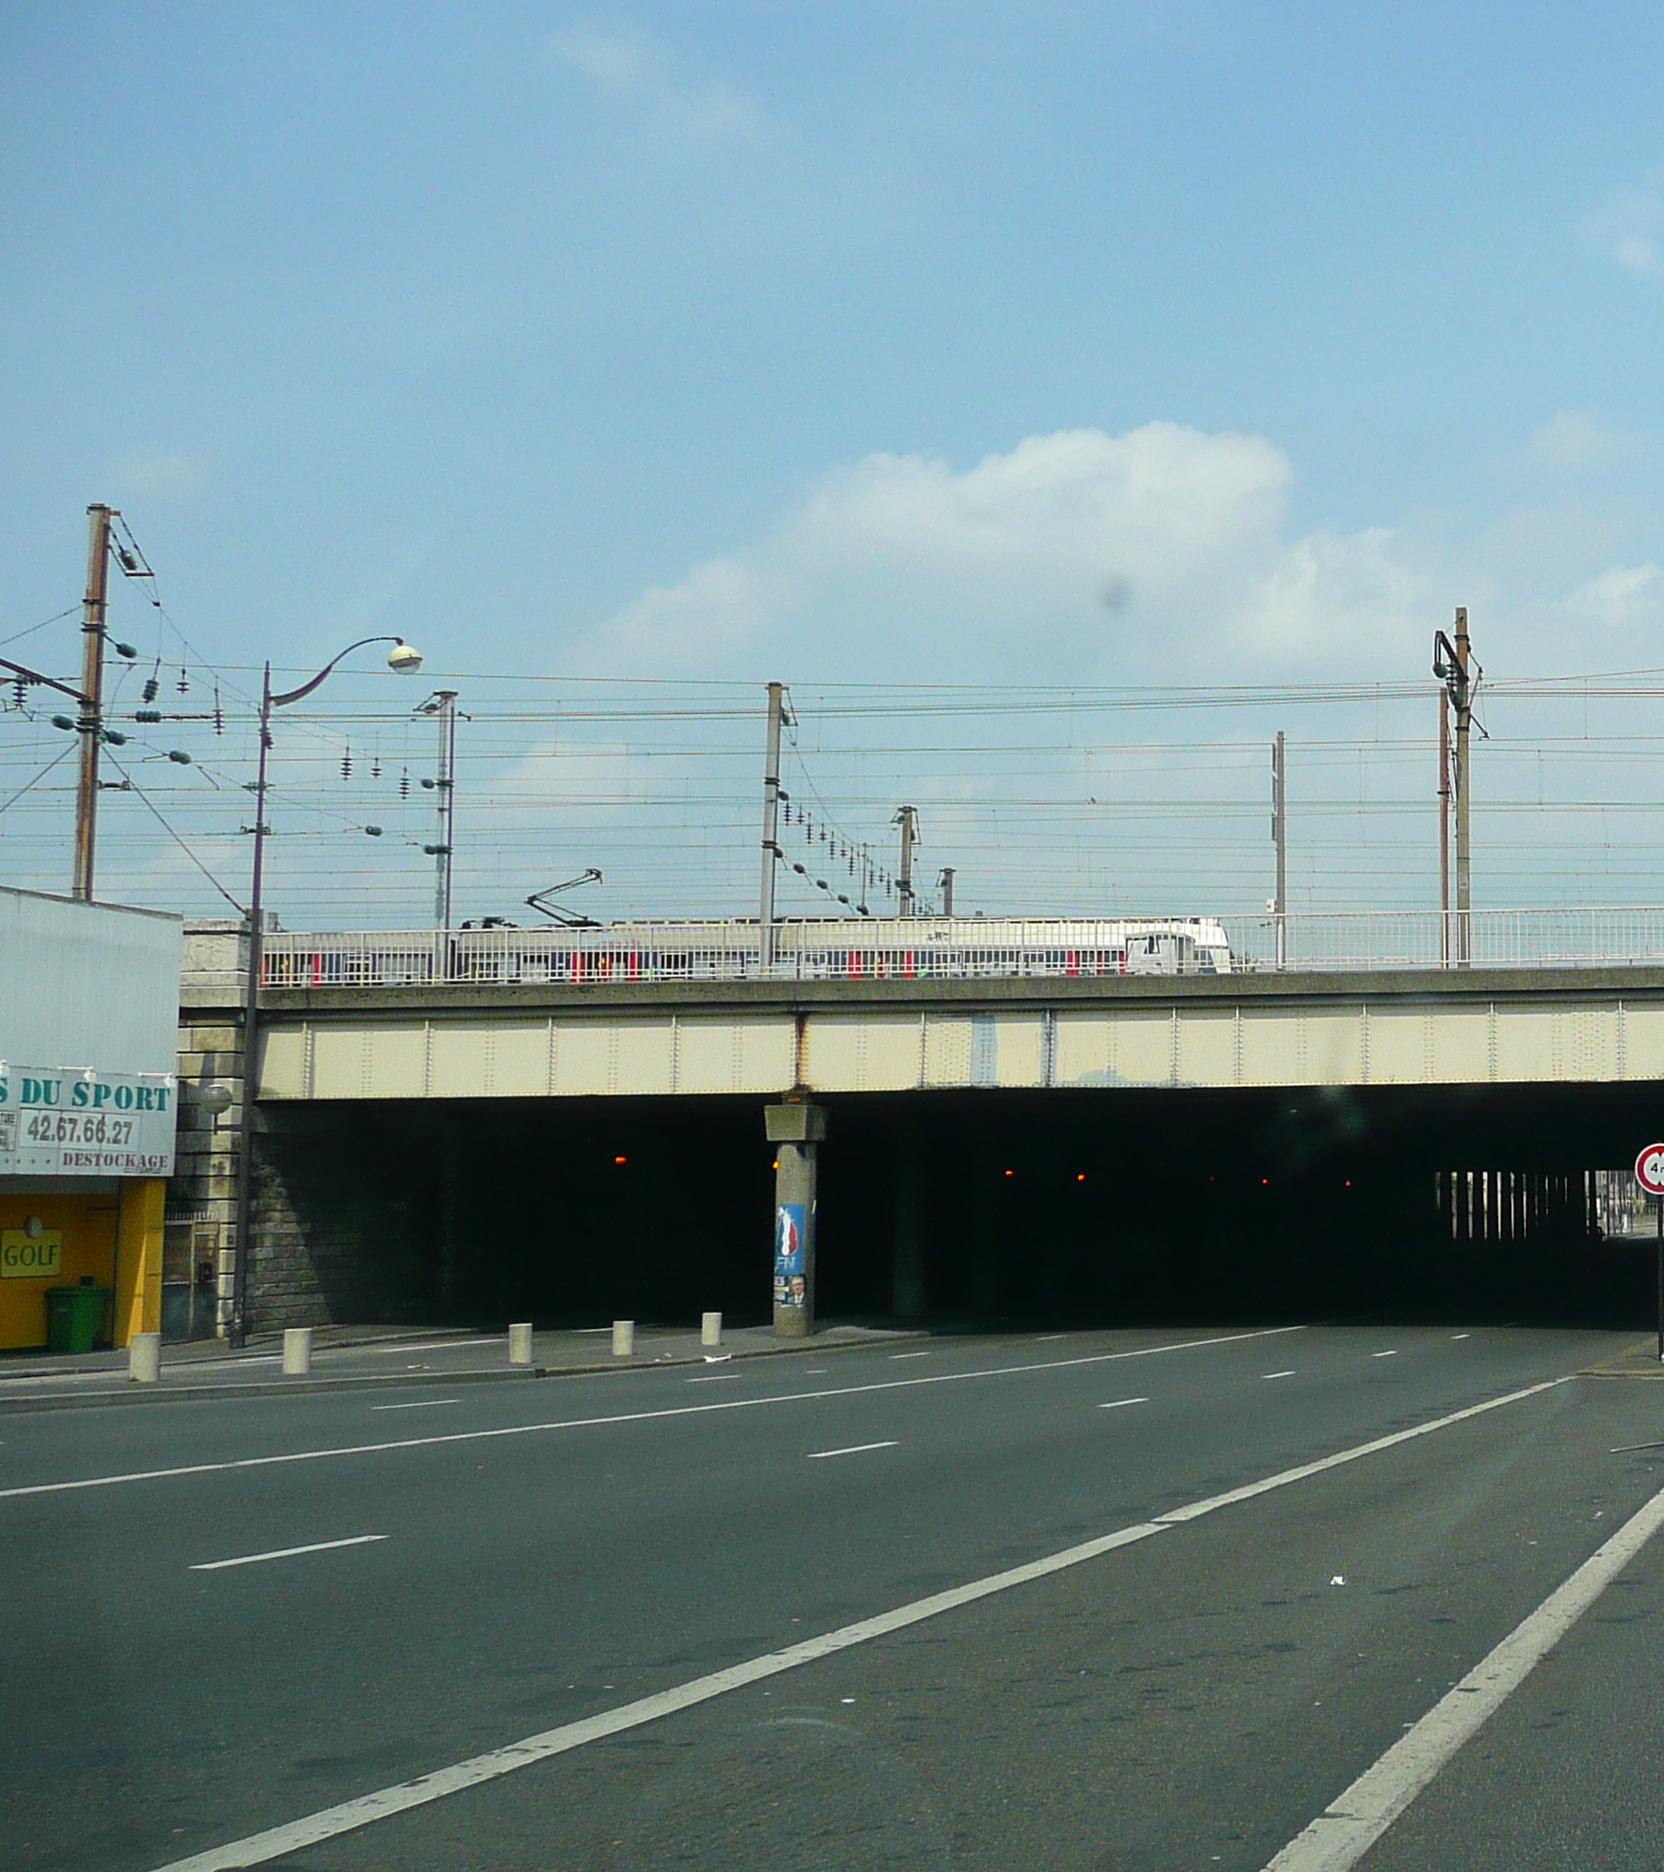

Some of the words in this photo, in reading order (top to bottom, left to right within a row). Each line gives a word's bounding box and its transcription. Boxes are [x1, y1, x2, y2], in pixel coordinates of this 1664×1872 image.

[20, 1078, 62, 1106] DU
[72, 1082, 170, 1112] SPORT
[27, 1114, 133, 1145] 42.67.66.27
[63, 1152, 168, 1168] DESTOCKAGE
[1650, 1162, 1658, 1173] 4
[4, 1244, 59, 1267] GOLF
[777, 1256, 796, 1270] FN
